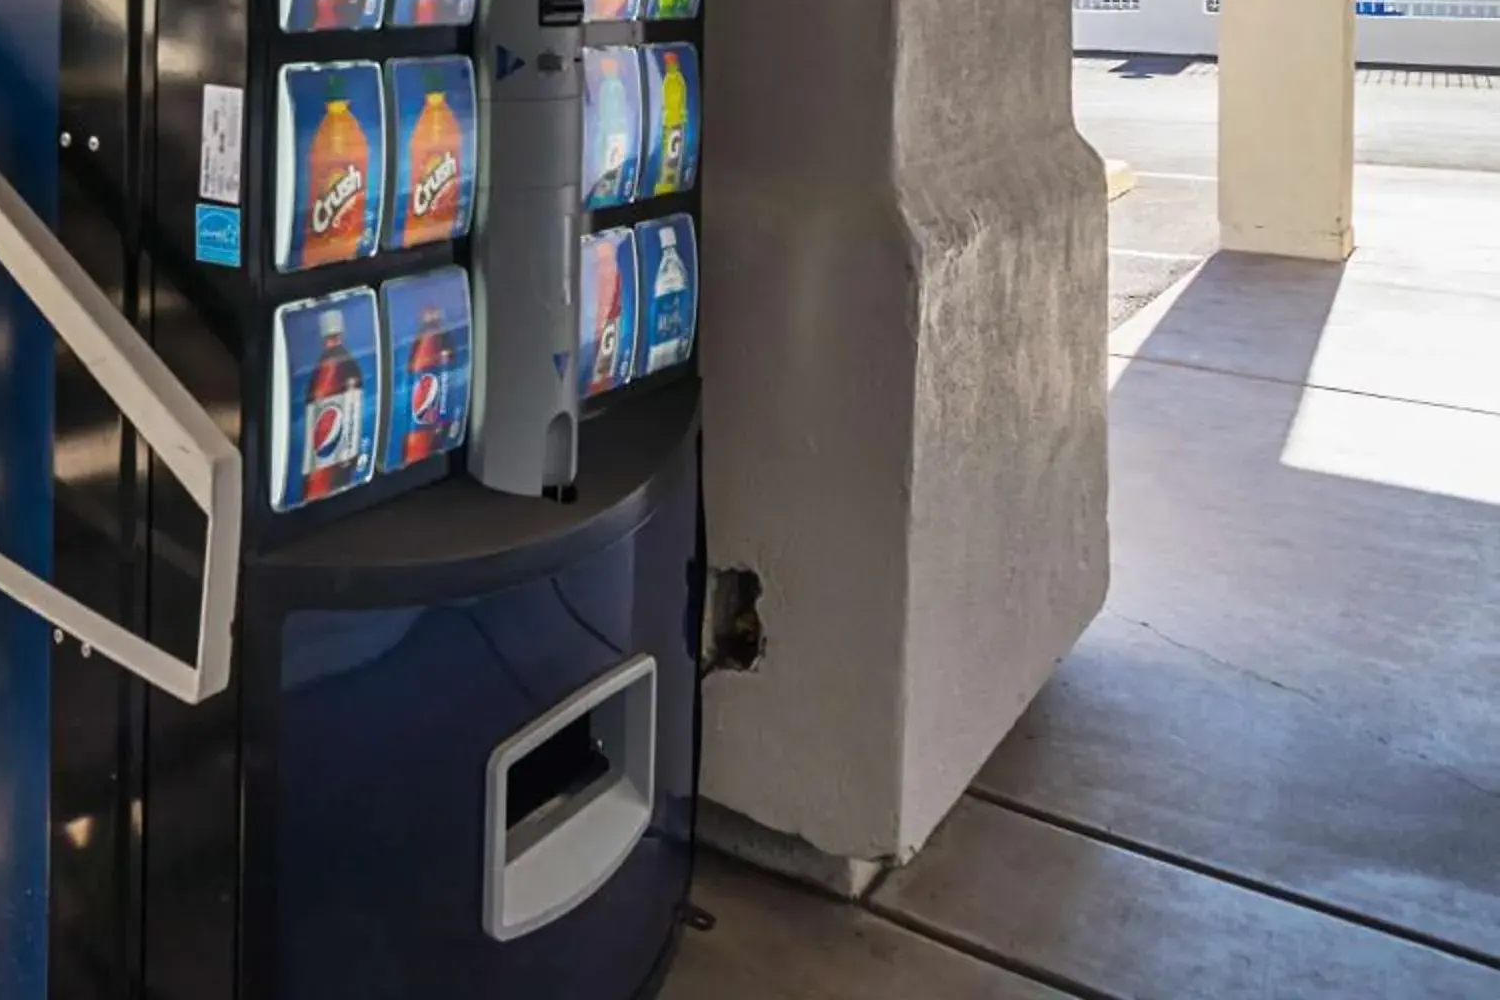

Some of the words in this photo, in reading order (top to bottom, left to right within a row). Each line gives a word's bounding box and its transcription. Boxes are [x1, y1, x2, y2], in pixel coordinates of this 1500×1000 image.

[312, 164, 362, 233] Crush
[413, 151, 457, 216] Crush
[601, 322, 615, 356] G
